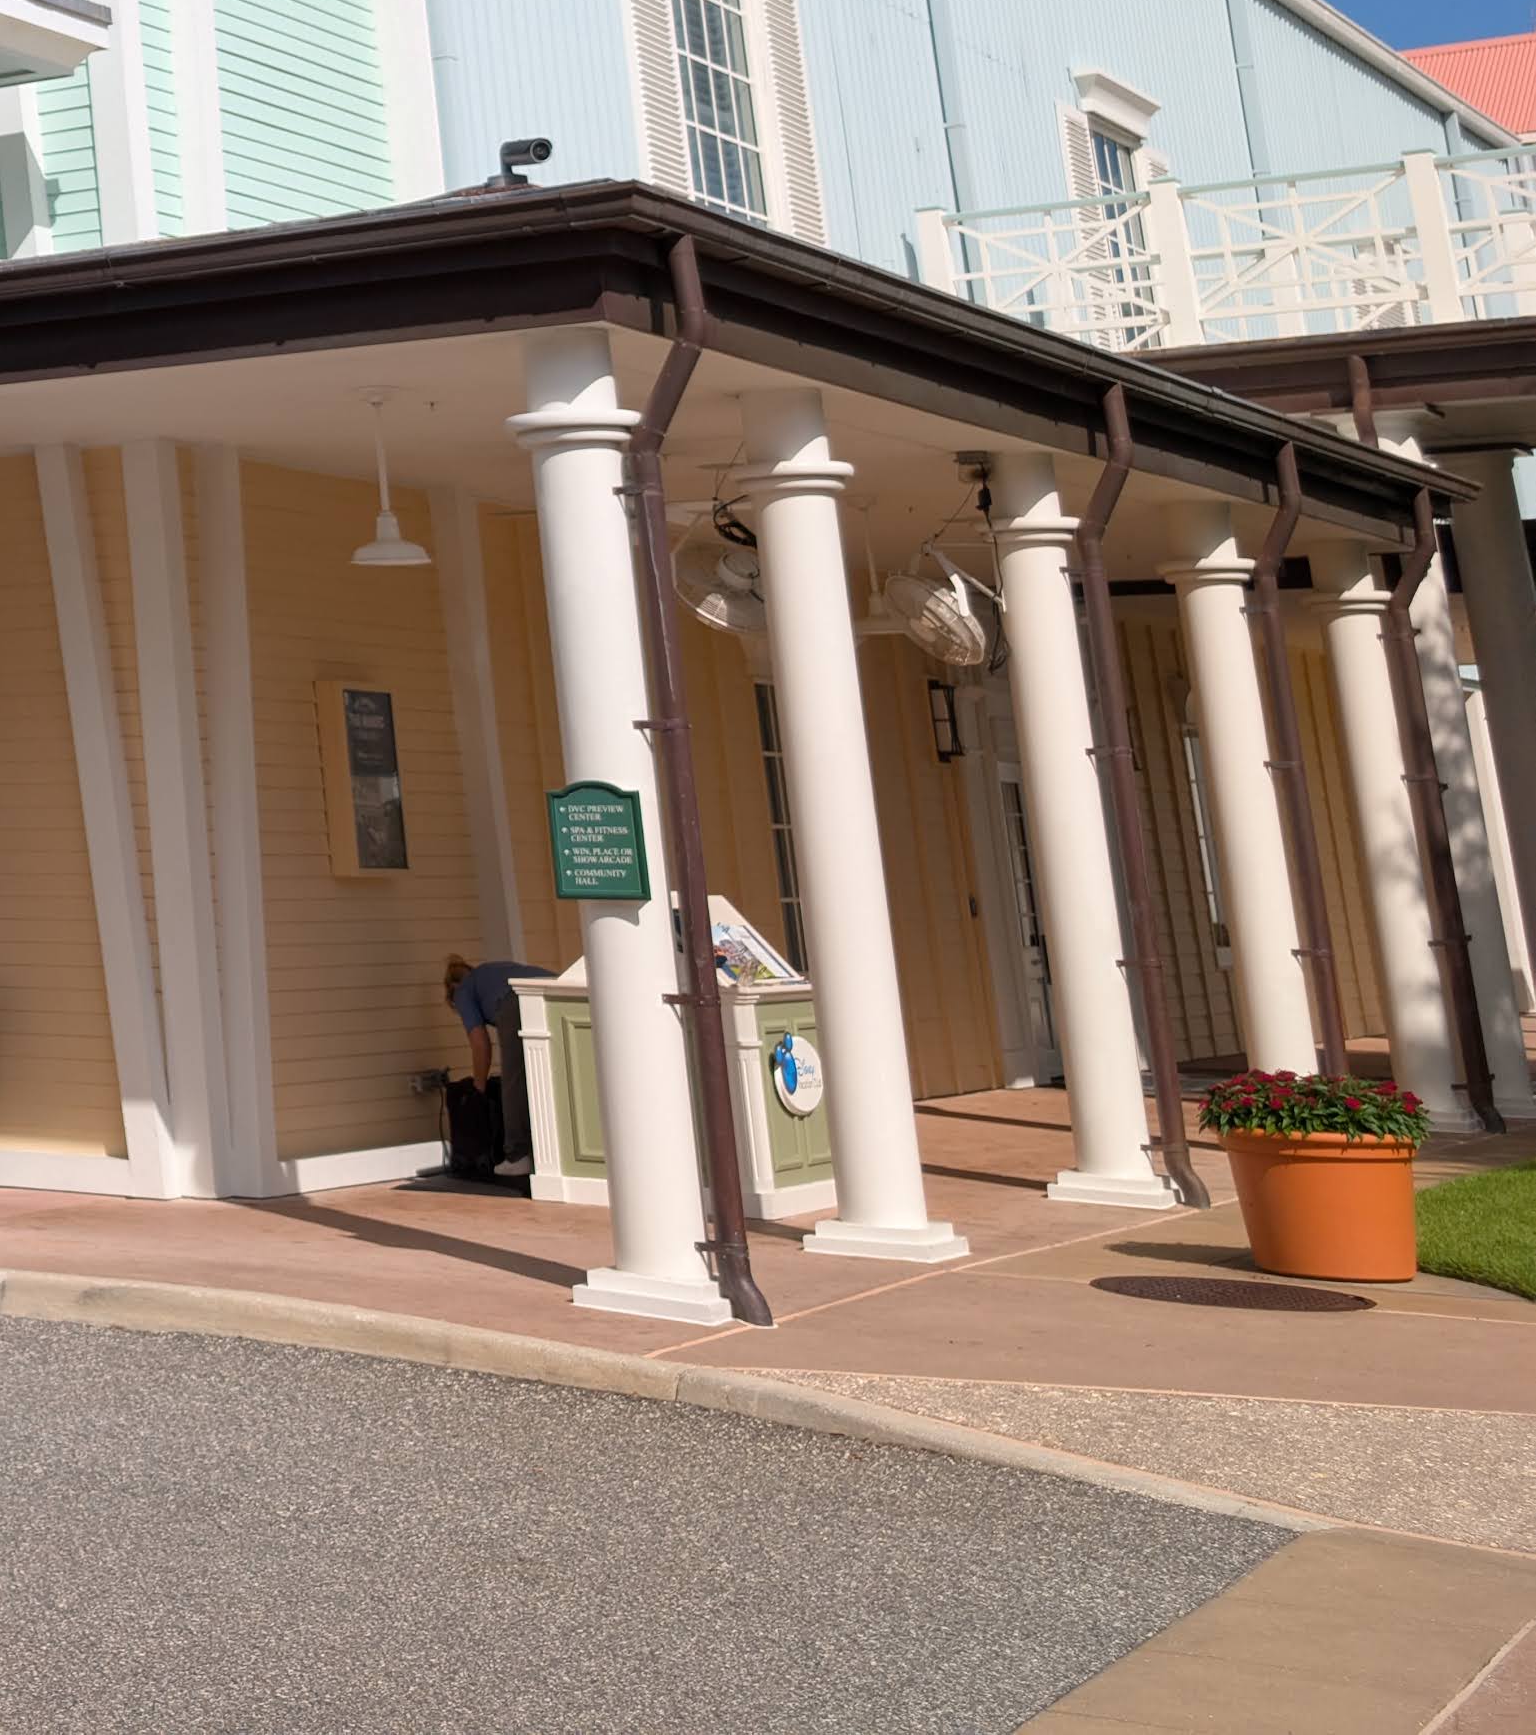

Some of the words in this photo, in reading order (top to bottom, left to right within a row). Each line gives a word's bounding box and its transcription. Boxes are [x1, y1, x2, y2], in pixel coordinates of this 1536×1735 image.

[568, 805, 586, 813] DVC
[587, 805, 624, 813] PREVIEW
[568, 813, 602, 821] CENTER
[570, 826, 585, 834] SPA
[594, 826, 629, 835] FITNESS
[592, 848, 619, 856] PLACE
[620, 848, 633, 856] OR
[573, 856, 597, 864] SHOW
[597, 856, 633, 864] ARCADE
[574, 869, 626, 878] COMMUNITY
[575, 877, 599, 885] HALL
